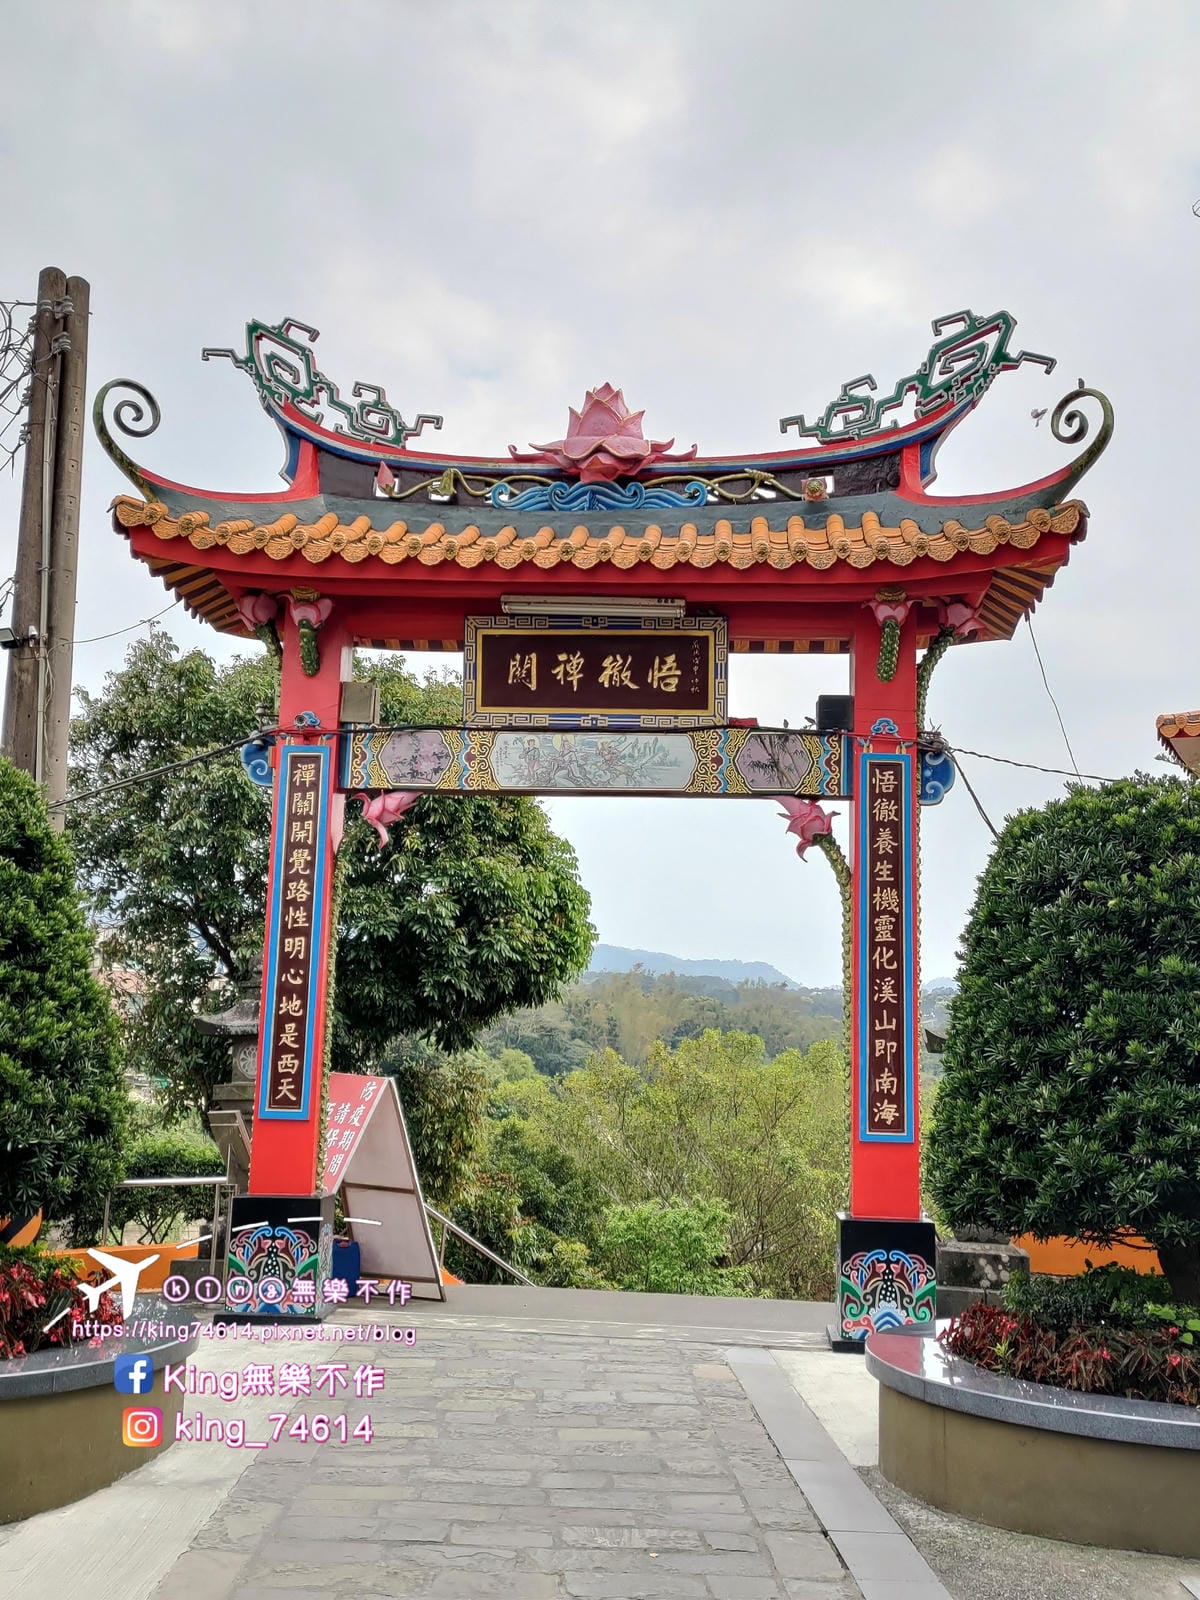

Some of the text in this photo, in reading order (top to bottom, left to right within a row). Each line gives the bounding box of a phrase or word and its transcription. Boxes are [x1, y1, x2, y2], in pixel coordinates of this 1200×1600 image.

[275, 763, 316, 1101] 禪關開覺路性明心地是西天
[872, 768, 900, 1126] 悟徹養生機靈化溪山即南海
